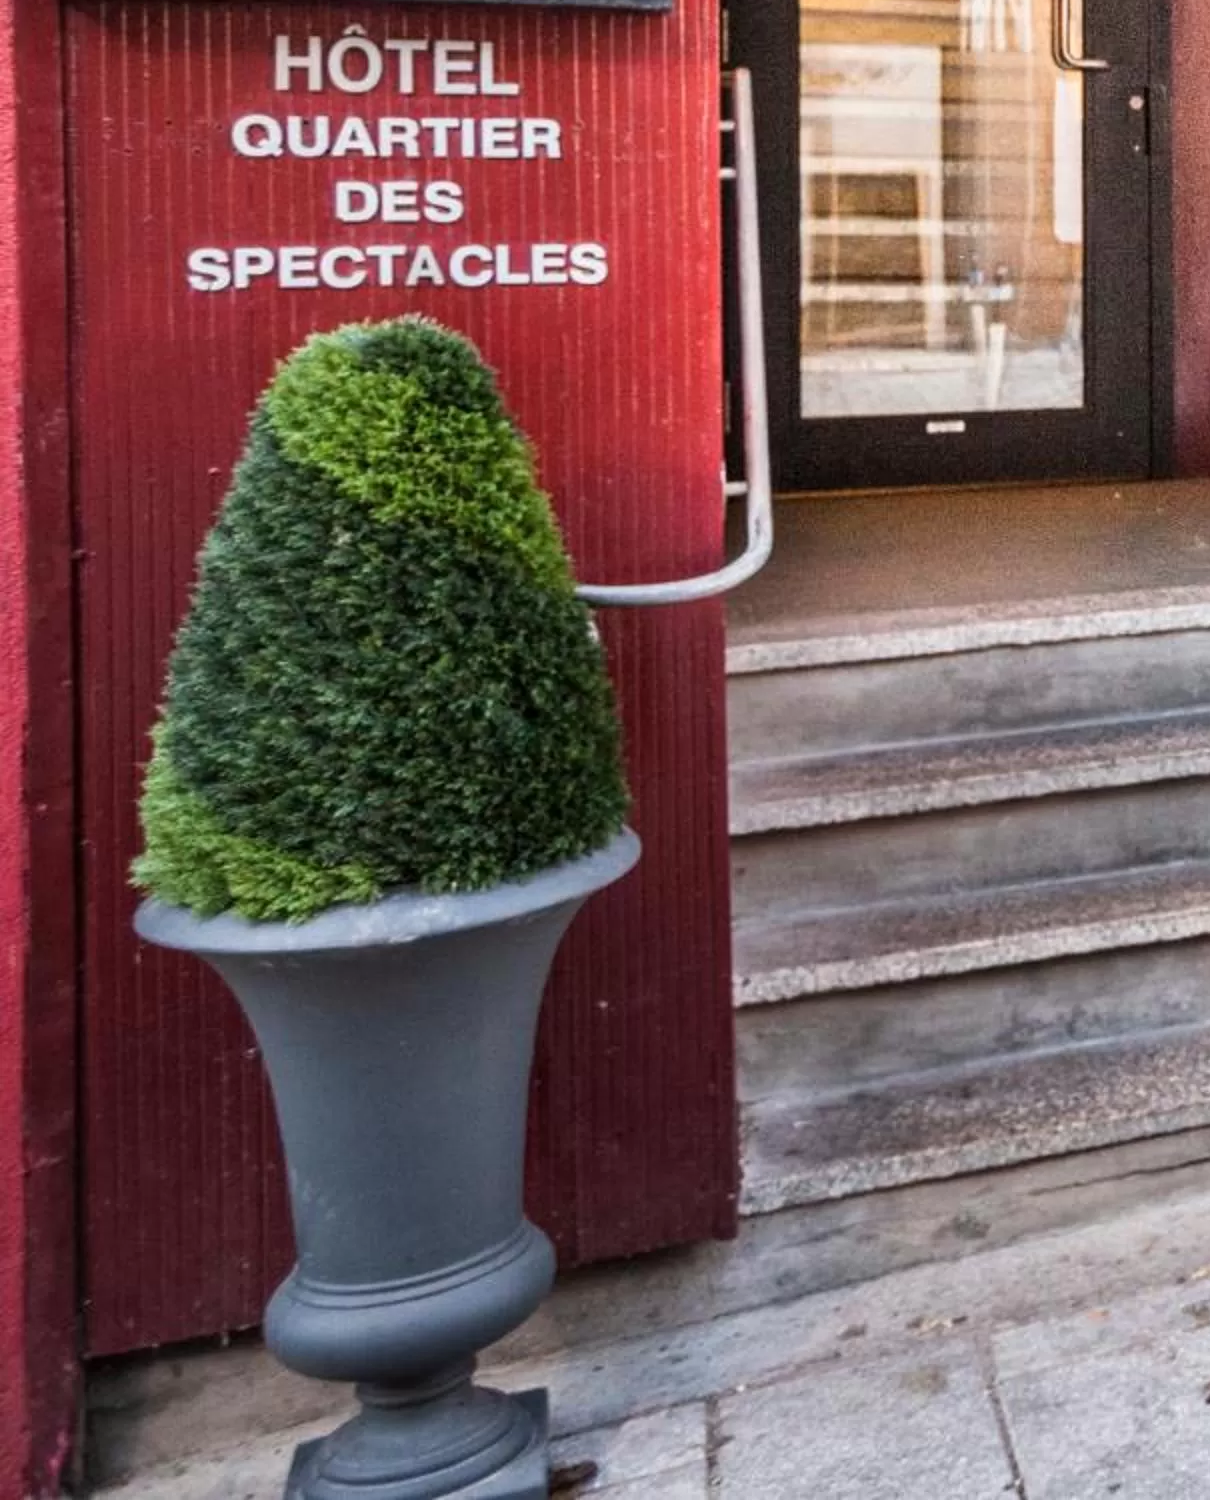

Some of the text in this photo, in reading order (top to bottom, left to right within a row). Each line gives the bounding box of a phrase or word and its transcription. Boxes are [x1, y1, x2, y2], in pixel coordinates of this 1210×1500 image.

[273, 24, 520, 96] HÔTEL
[231, 114, 562, 159] QUARTIER
[335, 181, 464, 223] DES
[187, 243, 608, 291] SPECTACLES
